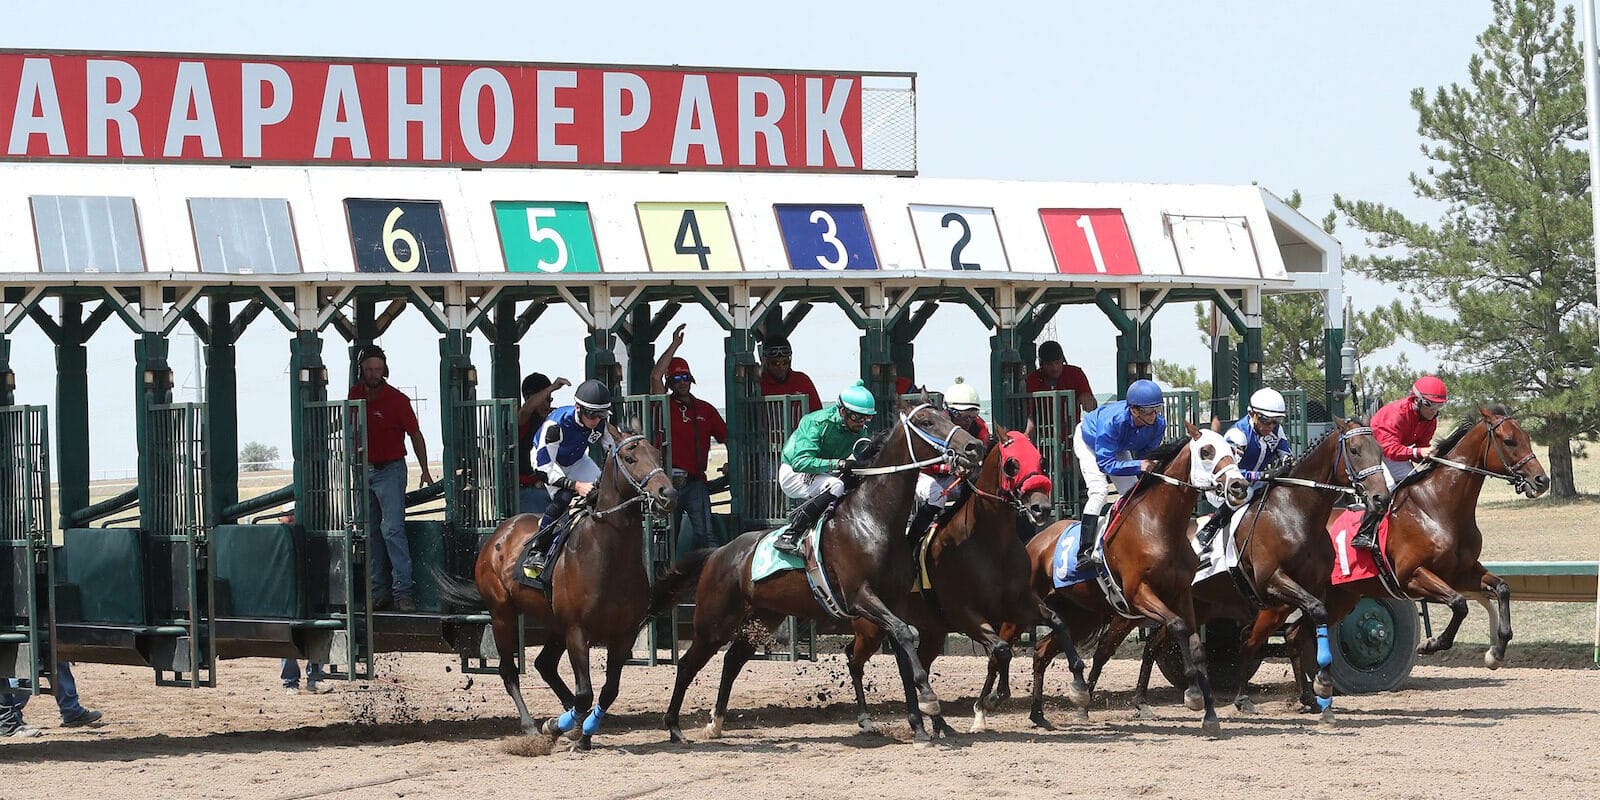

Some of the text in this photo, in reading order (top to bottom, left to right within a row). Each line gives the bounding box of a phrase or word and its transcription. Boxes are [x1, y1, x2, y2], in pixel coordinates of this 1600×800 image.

[382, 206, 420, 272] 6
[526, 207, 568, 272] 5
[674, 209, 711, 270] 4
[809, 210, 849, 270] 3
[941, 212, 981, 270] 2
[1075, 214, 1107, 273] 1
[1056, 535, 1076, 579] 3
[1335, 529, 1350, 576] 1
